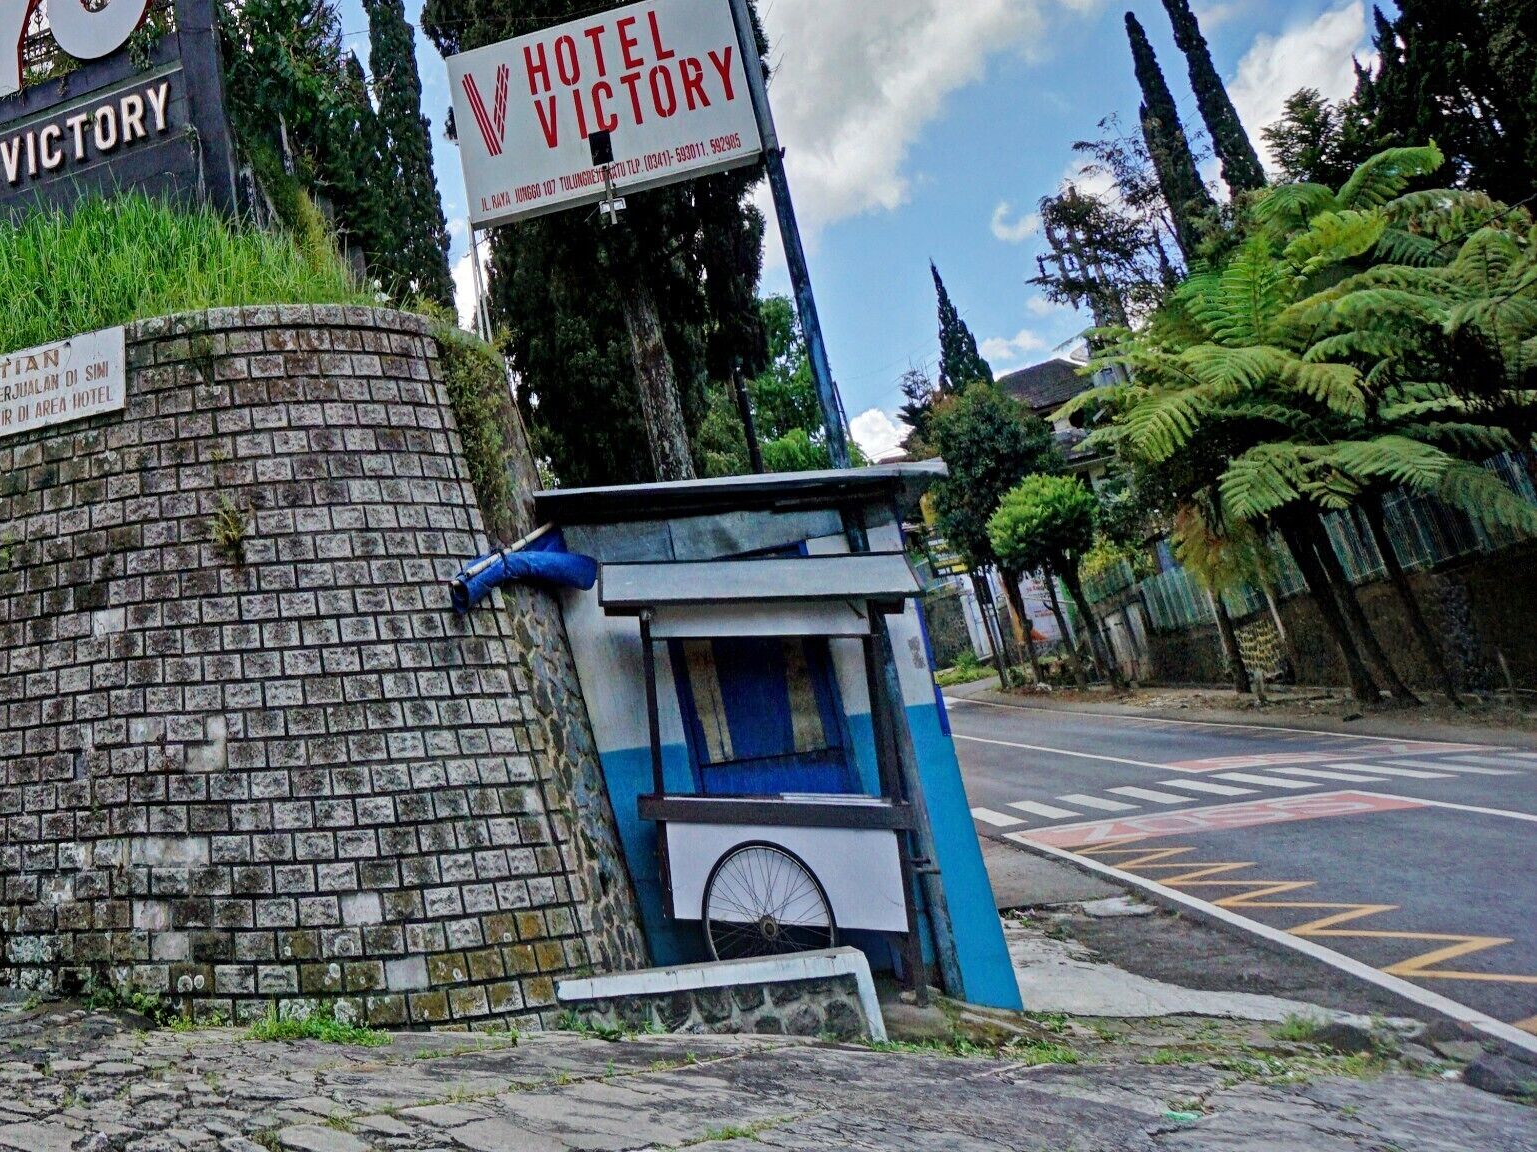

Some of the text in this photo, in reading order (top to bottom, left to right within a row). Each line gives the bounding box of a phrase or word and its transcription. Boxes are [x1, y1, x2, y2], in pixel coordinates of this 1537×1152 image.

[522, 10, 675, 95] HOTEL
[533, 45, 736, 149] VICTORY
[491, 191, 511, 209] RAYA
[514, 183, 542, 204] JUNGGO
[543, 179, 557, 197] 107
[65, 368, 79, 388] DI
[85, 360, 110, 382] SINI
[17, 403, 30, 423] DI
[35, 395, 68, 419] AREA
[72, 385, 115, 410] HOTEL
